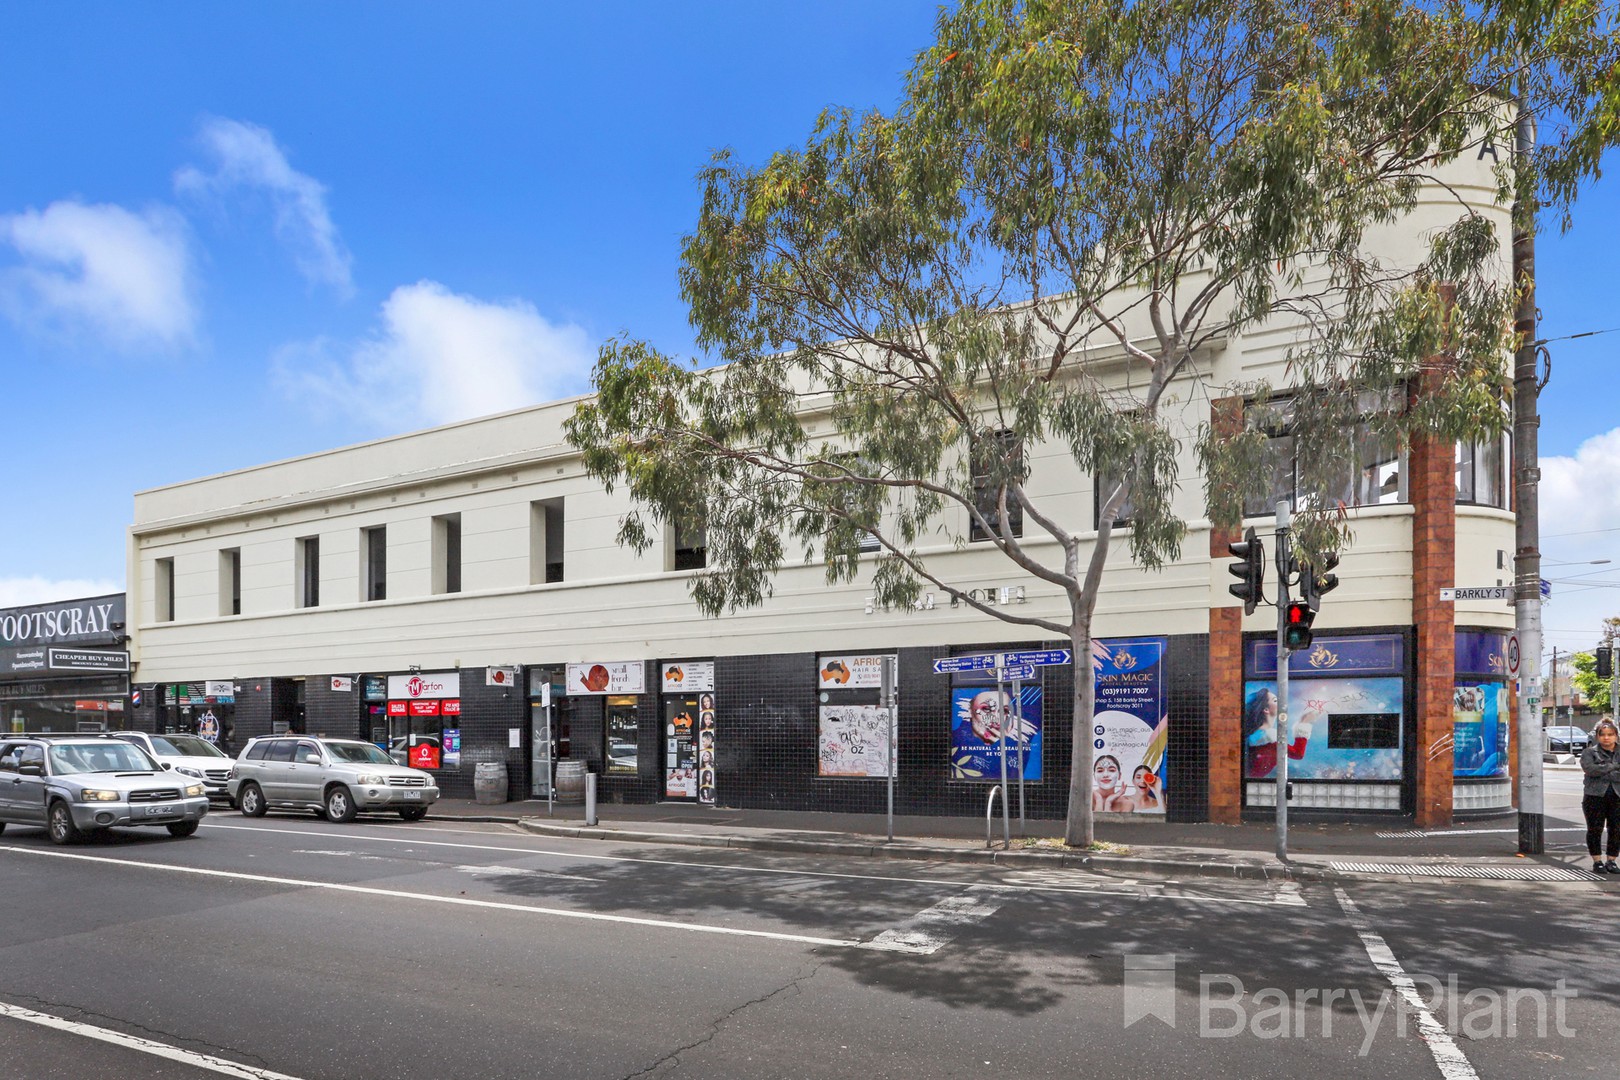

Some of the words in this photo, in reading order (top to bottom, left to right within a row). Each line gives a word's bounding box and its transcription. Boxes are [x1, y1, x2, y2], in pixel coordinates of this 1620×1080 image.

[1455, 588, 1490, 599] BARKLY
[1495, 588, 1506, 598] ST
[0, 603, 113, 641] OOTSCRAY
[1510, 645, 1518, 662] 40
[1097, 672, 1118, 683] SKIN
[1121, 673, 1153, 682] MAGIC
[1102, 688, 1130, 696] (03)9191
